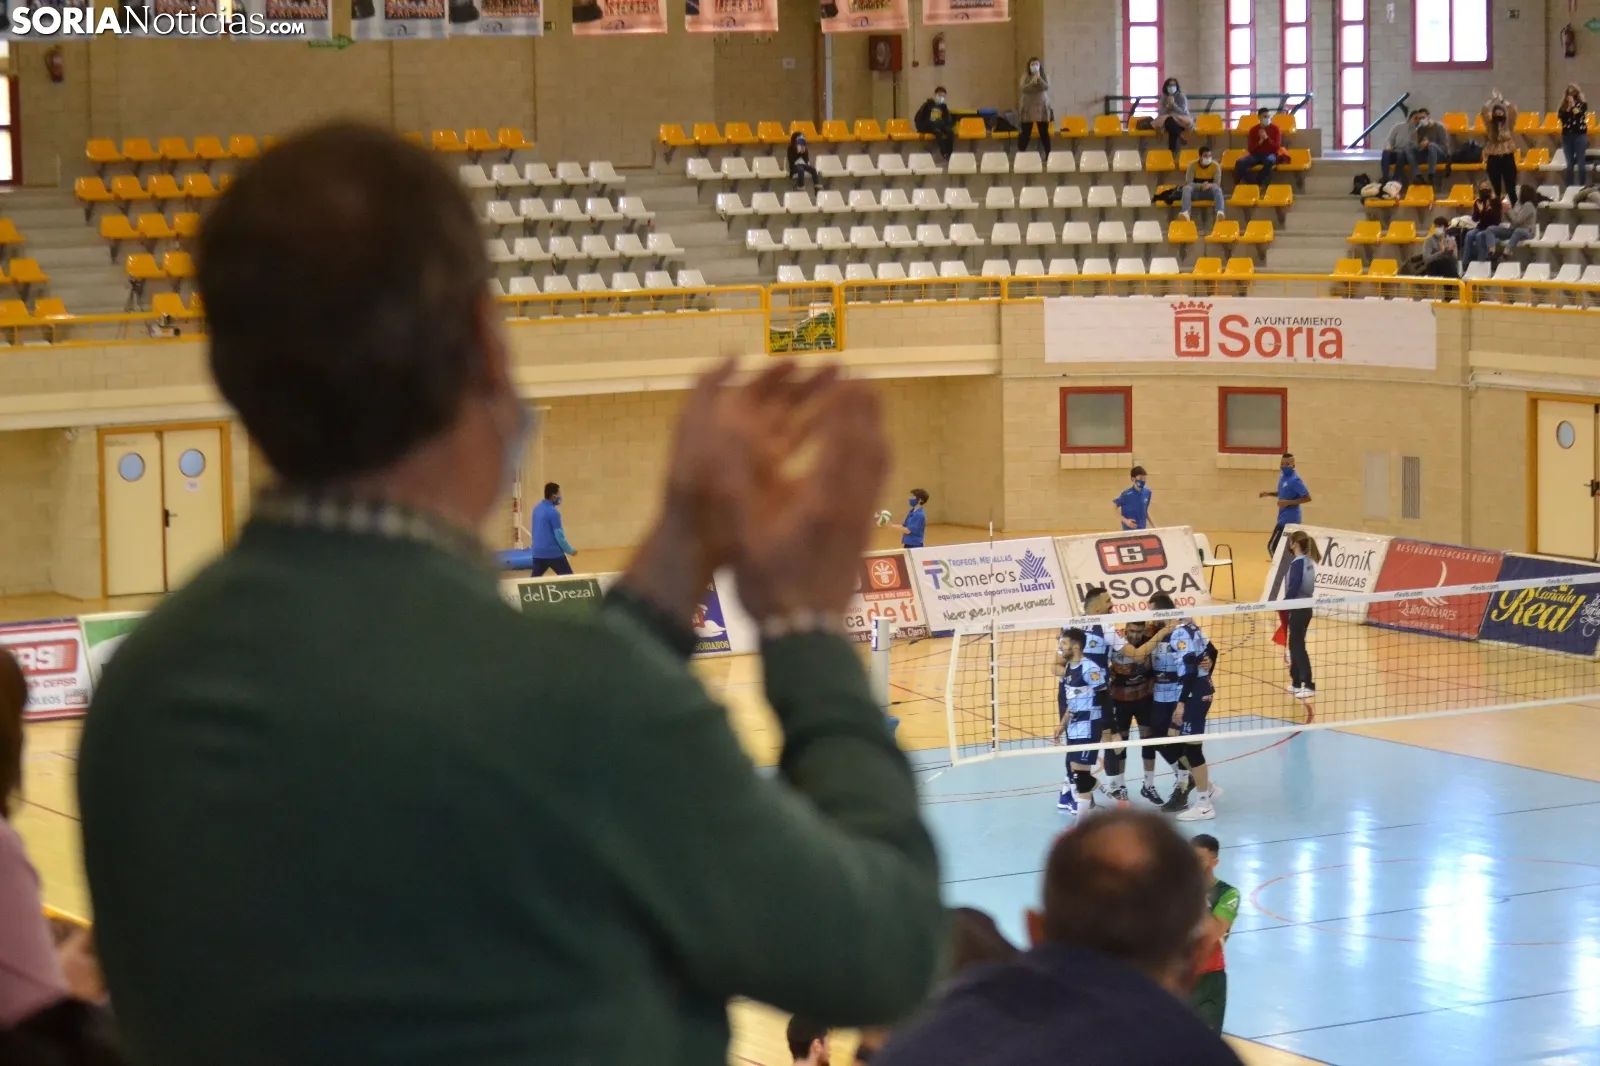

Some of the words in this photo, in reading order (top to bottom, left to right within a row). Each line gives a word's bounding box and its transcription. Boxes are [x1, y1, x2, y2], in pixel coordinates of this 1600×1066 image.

[1254, 316, 1342, 327] AYUNTAMIENTO
[1218, 314, 1343, 359] Soria
[523, 585, 544, 602] del
[546, 581, 594, 603] Brezal
[938, 591, 982, 602] equipaciones
[984, 587, 1020, 598] deportivas
[943, 608, 967, 621] Never
[1001, 602, 1024, 613] move
[1491, 587, 1587, 633] Real
